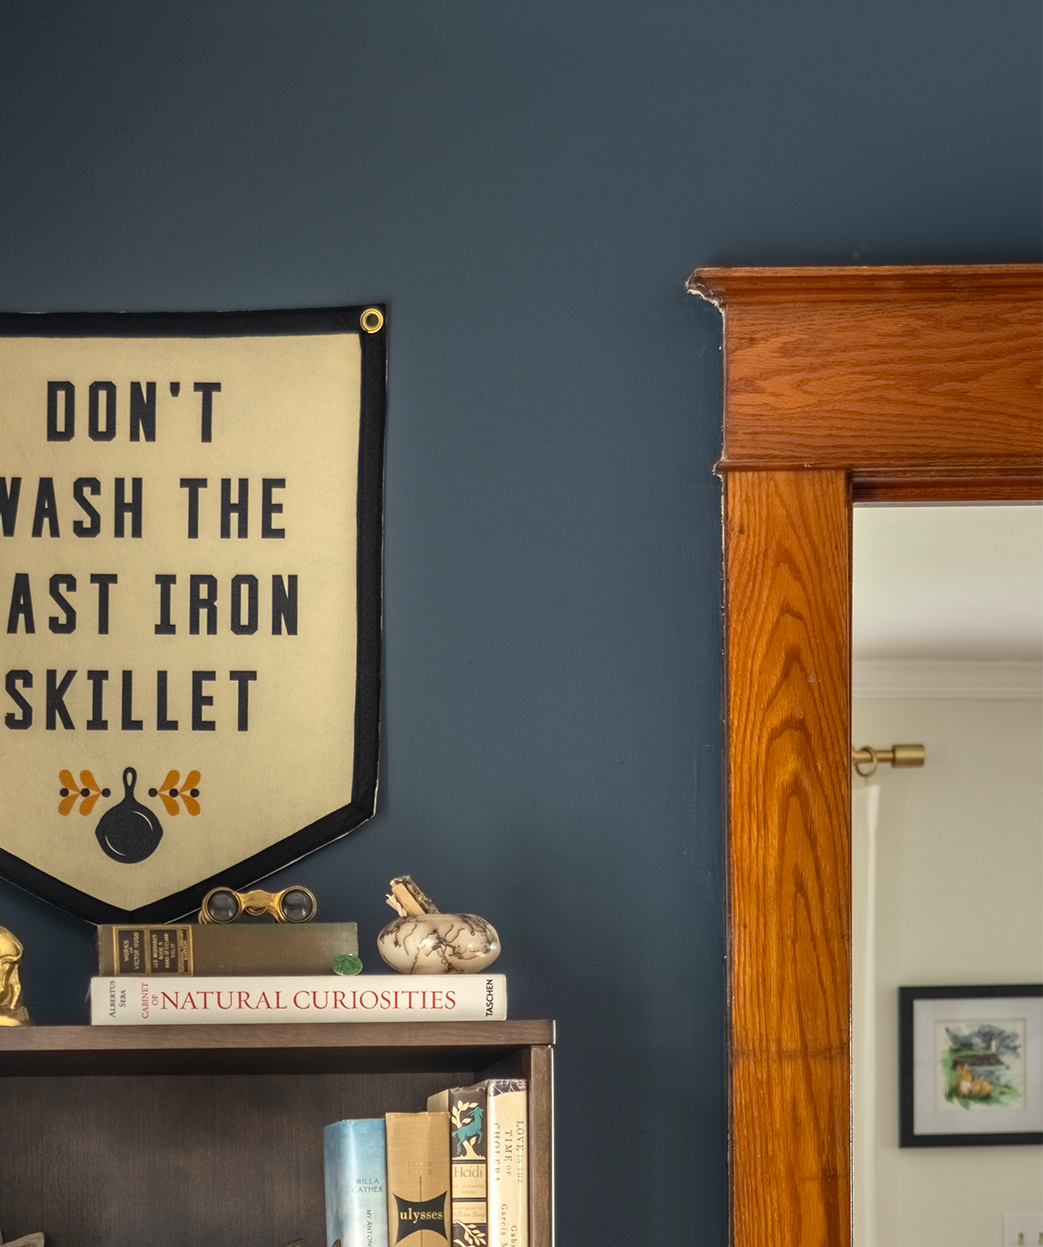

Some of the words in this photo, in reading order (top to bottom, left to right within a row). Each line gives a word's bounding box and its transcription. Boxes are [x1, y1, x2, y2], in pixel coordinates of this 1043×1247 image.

[46, 381, 221, 443] DON'T
[180, 478, 286, 539] THE
[154, 574, 298, 636] IRON
[5, 669, 257, 732] SKILLET
[141, 982, 149, 1019] CABINET
[151, 994, 159, 1006] OF
[160, 990, 288, 1010] NATURAL
[293, 989, 457, 1011] CURIOSITIES
[485, 979, 494, 1017] TASCHEN
[493, 1122, 501, 1182] CHOLERA
[504, 1130, 512, 1162] TIME
[516, 1121, 524, 1151] LOVE
[454, 1165, 484, 1178] Heidi
[506, 1165, 512, 1176] OF
[366, 1209, 372, 1219] MY
[399, 1207, 443, 1224] ulysses
[500, 1203, 508, 1236] García
